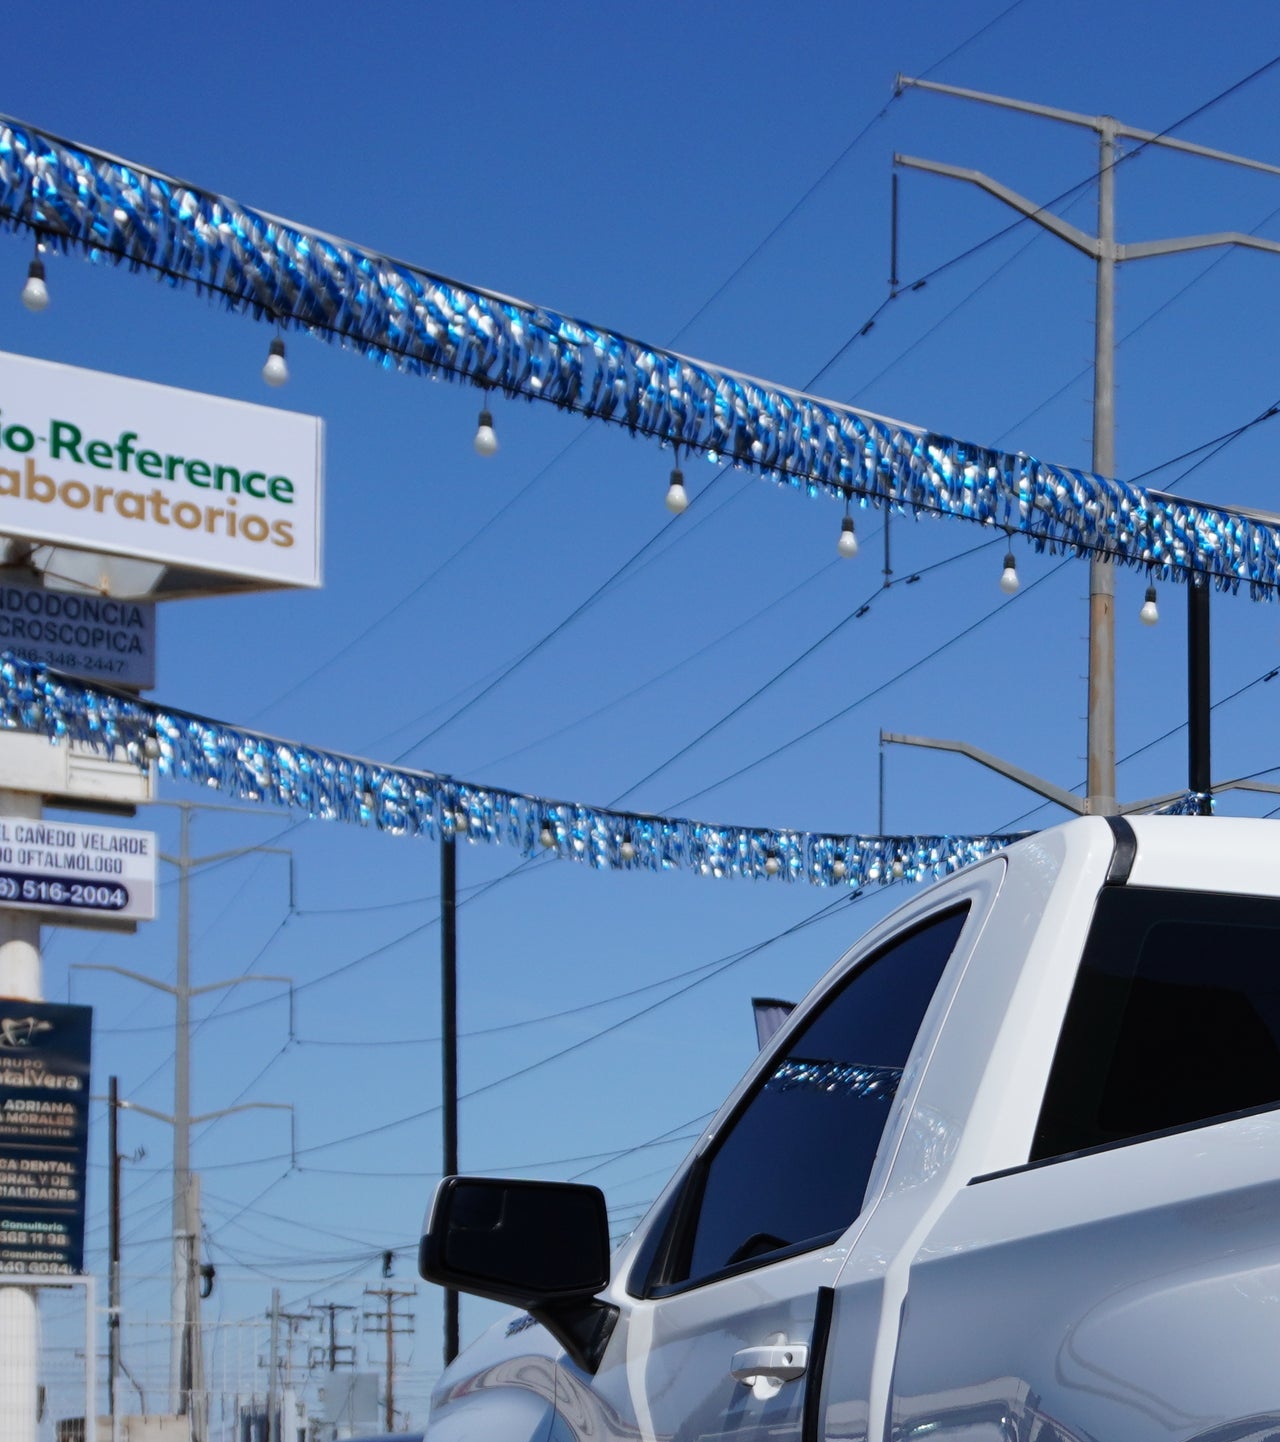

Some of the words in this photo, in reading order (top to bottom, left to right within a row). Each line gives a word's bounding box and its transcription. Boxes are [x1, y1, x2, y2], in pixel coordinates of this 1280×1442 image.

[0, 586, 144, 629] DODONCIA
[15, 825, 76, 848] CAÑEDO
[81, 832, 148, 855] VELARDE
[17, 850, 123, 874] OFTALMÓLOGO
[22, 880, 124, 905] 516-2004
[20, 1159, 75, 1173] DENTAL
